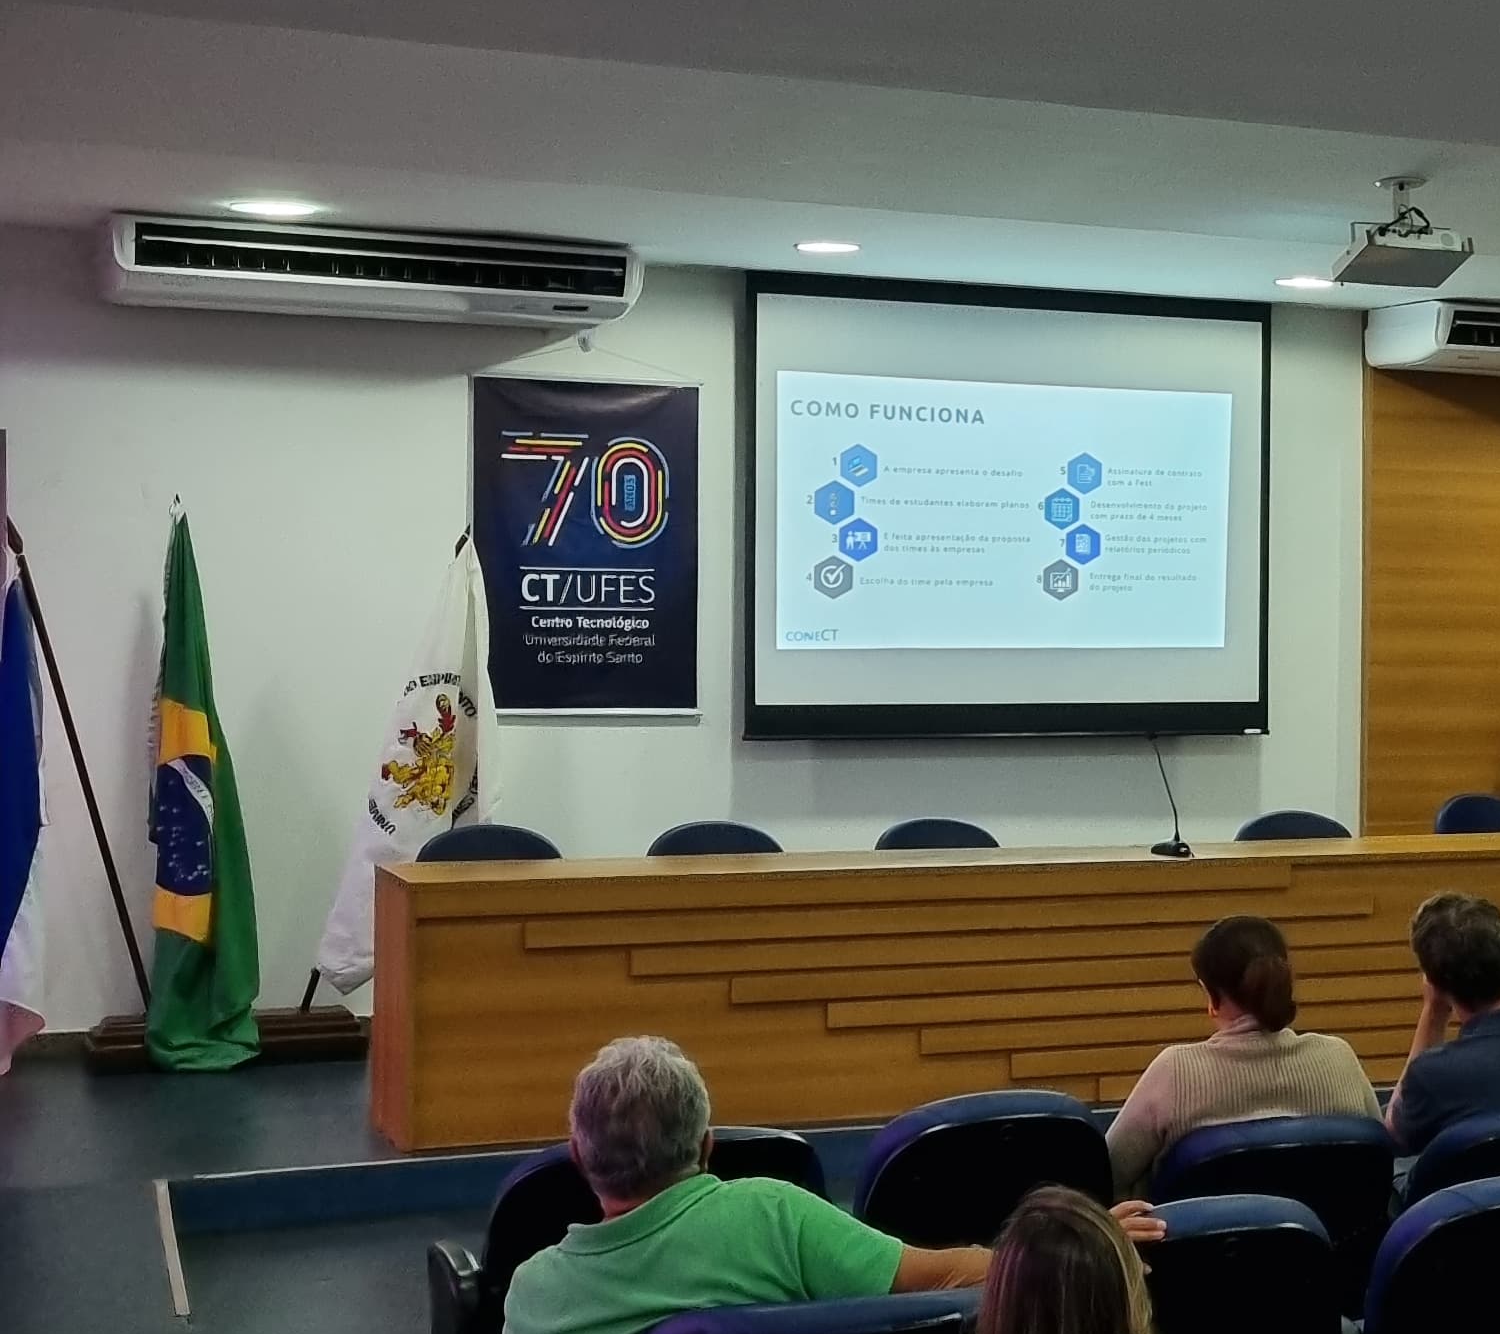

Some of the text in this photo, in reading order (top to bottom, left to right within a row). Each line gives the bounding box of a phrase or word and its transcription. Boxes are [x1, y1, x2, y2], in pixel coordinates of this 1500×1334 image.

[790, 399, 985, 425] COMO FUNCIONA
[832, 456, 838, 466] 1
[893, 466, 932, 476] empresa
[935, 467, 979, 477] apresenta
[1060, 466, 1067, 476] 5
[501, 430, 669, 548] 70
[806, 494, 813, 505] 2
[860, 496, 1030, 510] Times de estudantes elaboram planos
[1038, 501, 1044, 511] 6
[831, 533, 838, 544] 3
[1060, 538, 1065, 548] 7
[943, 545, 986, 555] empresas
[806, 572, 812, 582] 4
[520, 573, 656, 605] CT/UFES
[955, 579, 994, 588] empresa
[531, 615, 650, 631] Centro Tecnológico
[524, 633, 655, 647] Universidade Federal
[537, 650, 553, 663] do
[605, 651, 643, 664] Santo
